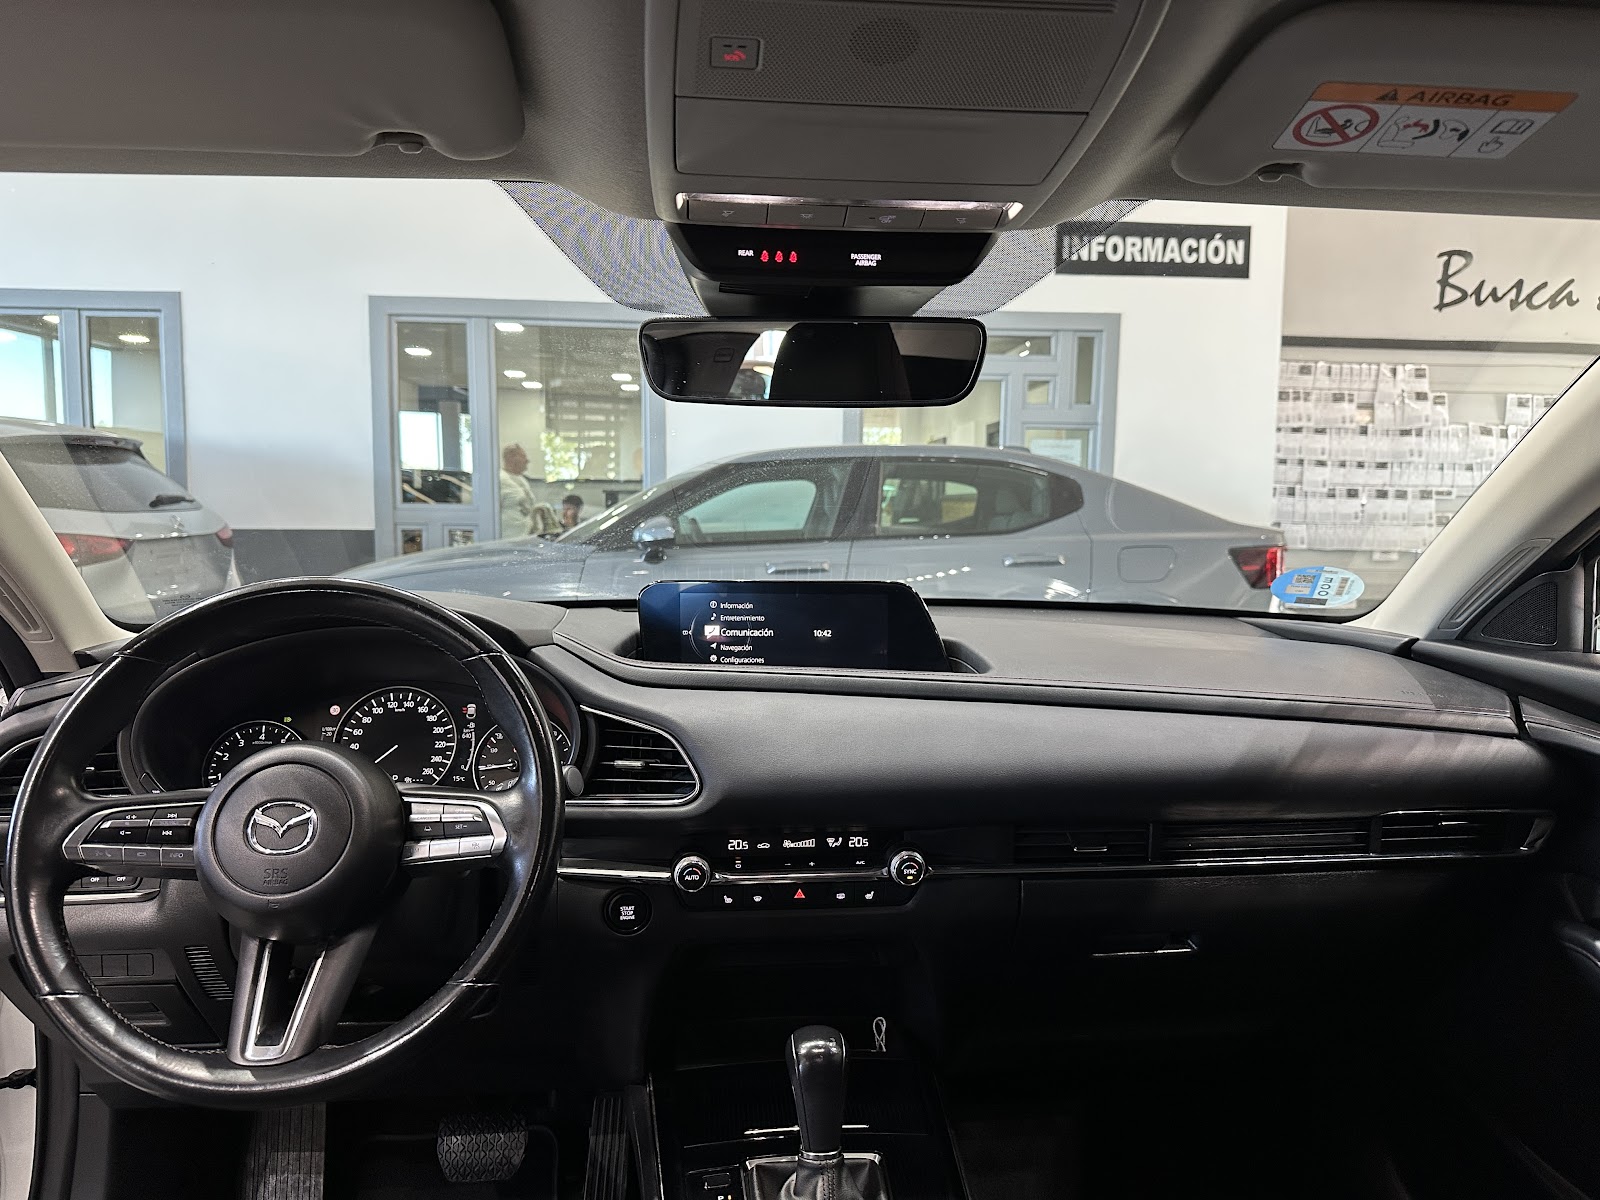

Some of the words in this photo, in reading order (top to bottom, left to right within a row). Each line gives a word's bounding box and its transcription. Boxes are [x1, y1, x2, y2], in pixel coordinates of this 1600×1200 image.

[1405, 90, 1516, 107] AIRBAG
[1062, 232, 1246, 265] INFORMACIÓN
[738, 249, 754, 257] REAR
[850, 253, 882, 261] PASSENGER
[1433, 249, 1580, 312] Busca
[720, 602, 754, 610] Información
[720, 614, 765, 622] Entretenimiento
[720, 627, 774, 637] Comunicación
[813, 629, 832, 638] 10:42
[720, 644, 753, 652] Navegación
[720, 656, 765, 664] Configuraciones
[418, 706, 429, 714] 160
[362, 716, 372, 724] 80
[353, 728, 363, 736] 60
[238, 739, 245, 747] 3
[222, 753, 229, 761] 2
[217, 773, 222, 781] 1
[263, 868, 288, 879] SRS
